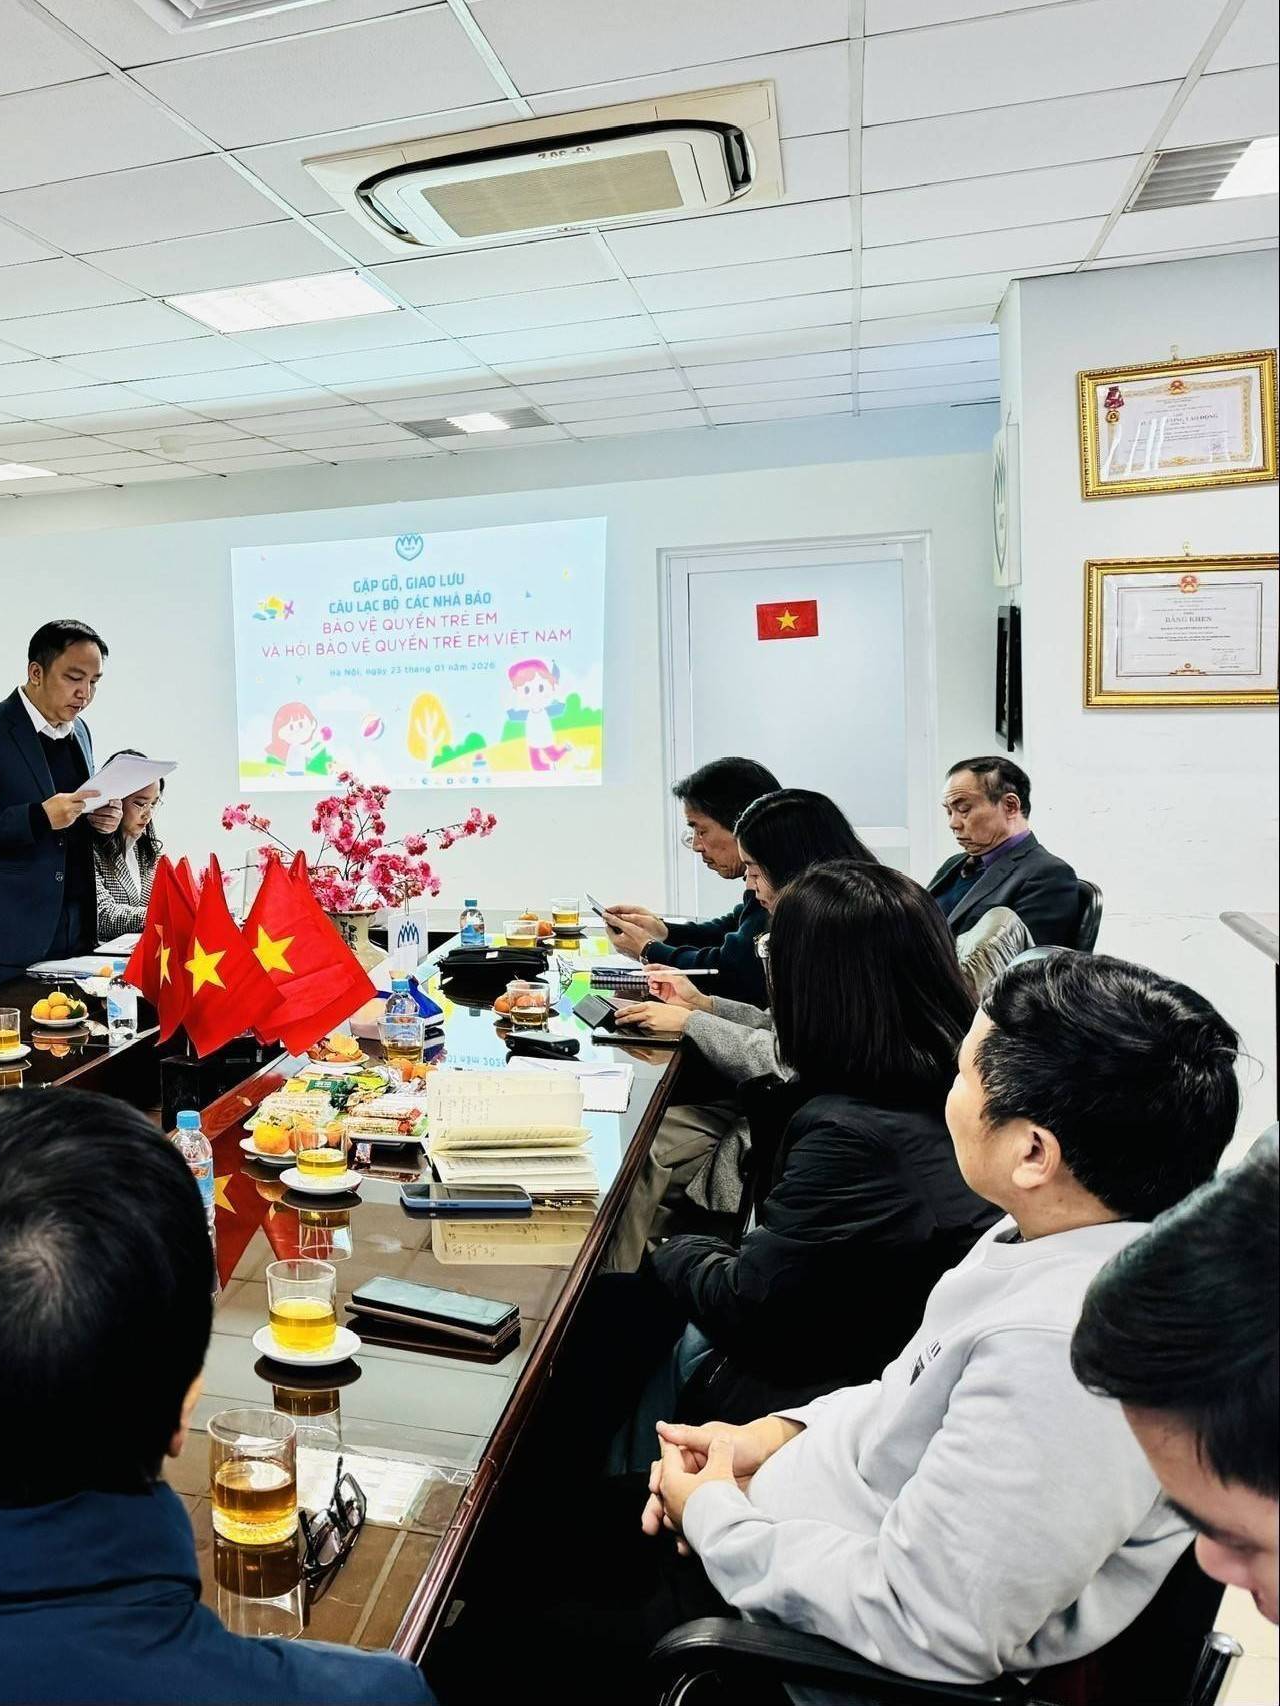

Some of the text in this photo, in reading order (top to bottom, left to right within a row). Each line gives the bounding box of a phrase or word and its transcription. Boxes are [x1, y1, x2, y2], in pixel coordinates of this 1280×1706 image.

[353, 577, 378, 596] GẶP
[406, 575, 436, 590] GIAO
[439, 573, 465, 587] LƯU
[328, 598, 353, 614] CÂU
[356, 600, 379, 615] LẠC
[406, 592, 430, 610] CÁC
[433, 590, 462, 607] NHÀ
[465, 589, 492, 605] BÁO
[322, 609, 498, 635] BẢO VỆ QUYỀN TRẺ EM
[262, 628, 572, 659] VÀ HỘI BẢO VỆ QUYỀN TRẺ EM VIỆT NAM
[391, 665, 401, 675] 23
[434, 664, 445, 673] 01
[471, 661, 496, 671] 2026
